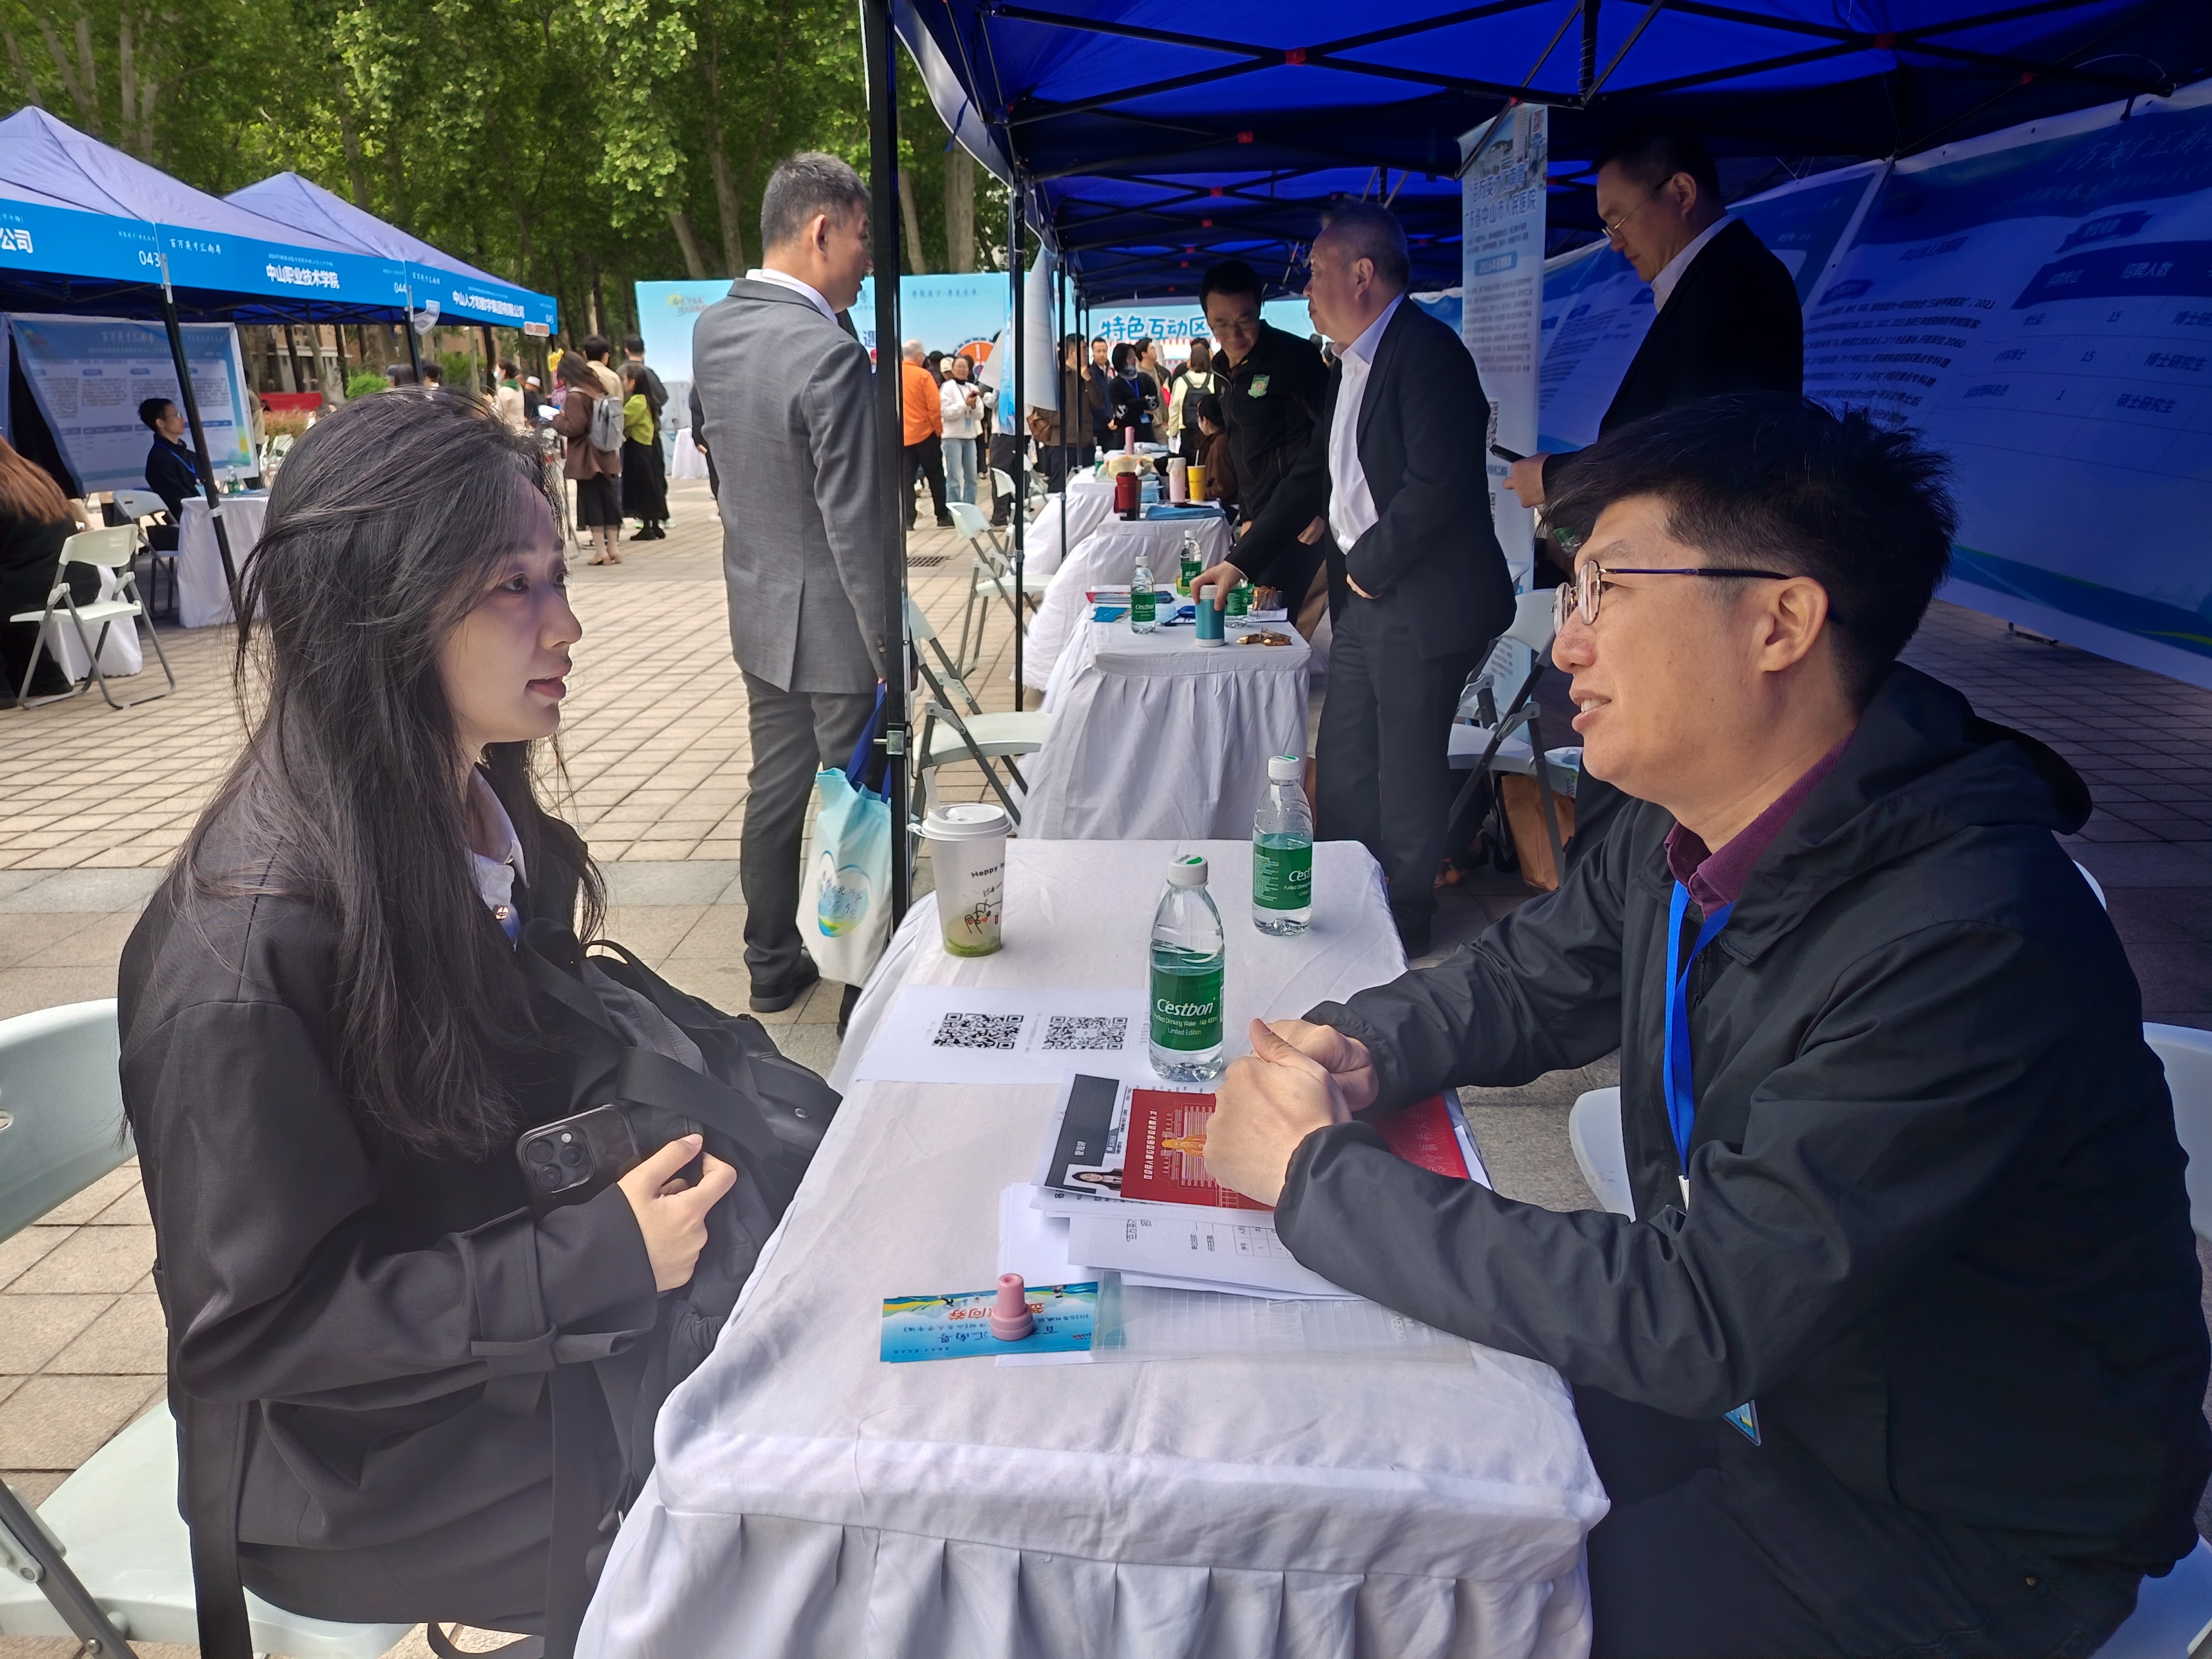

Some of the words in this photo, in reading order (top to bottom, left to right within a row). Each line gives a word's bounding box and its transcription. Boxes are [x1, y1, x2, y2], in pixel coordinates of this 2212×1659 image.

[139, 250, 161, 267] 043
[266, 263, 340, 289] 中山职业技术学院
[2120, 261, 2174, 279] 招聘人数
[2107, 310, 2124, 322] 15
[1096, 315, 1211, 341] 特色互动区
[2079, 351, 2096, 362] 15
[2143, 352, 2208, 371] 博士研究生
[2115, 393, 2177, 414] 硕士研究生
[971, 866, 998, 878] Happy
[1166, 1017, 1183, 1027] Drinking
[1168, 1027, 1185, 1035] Limited
